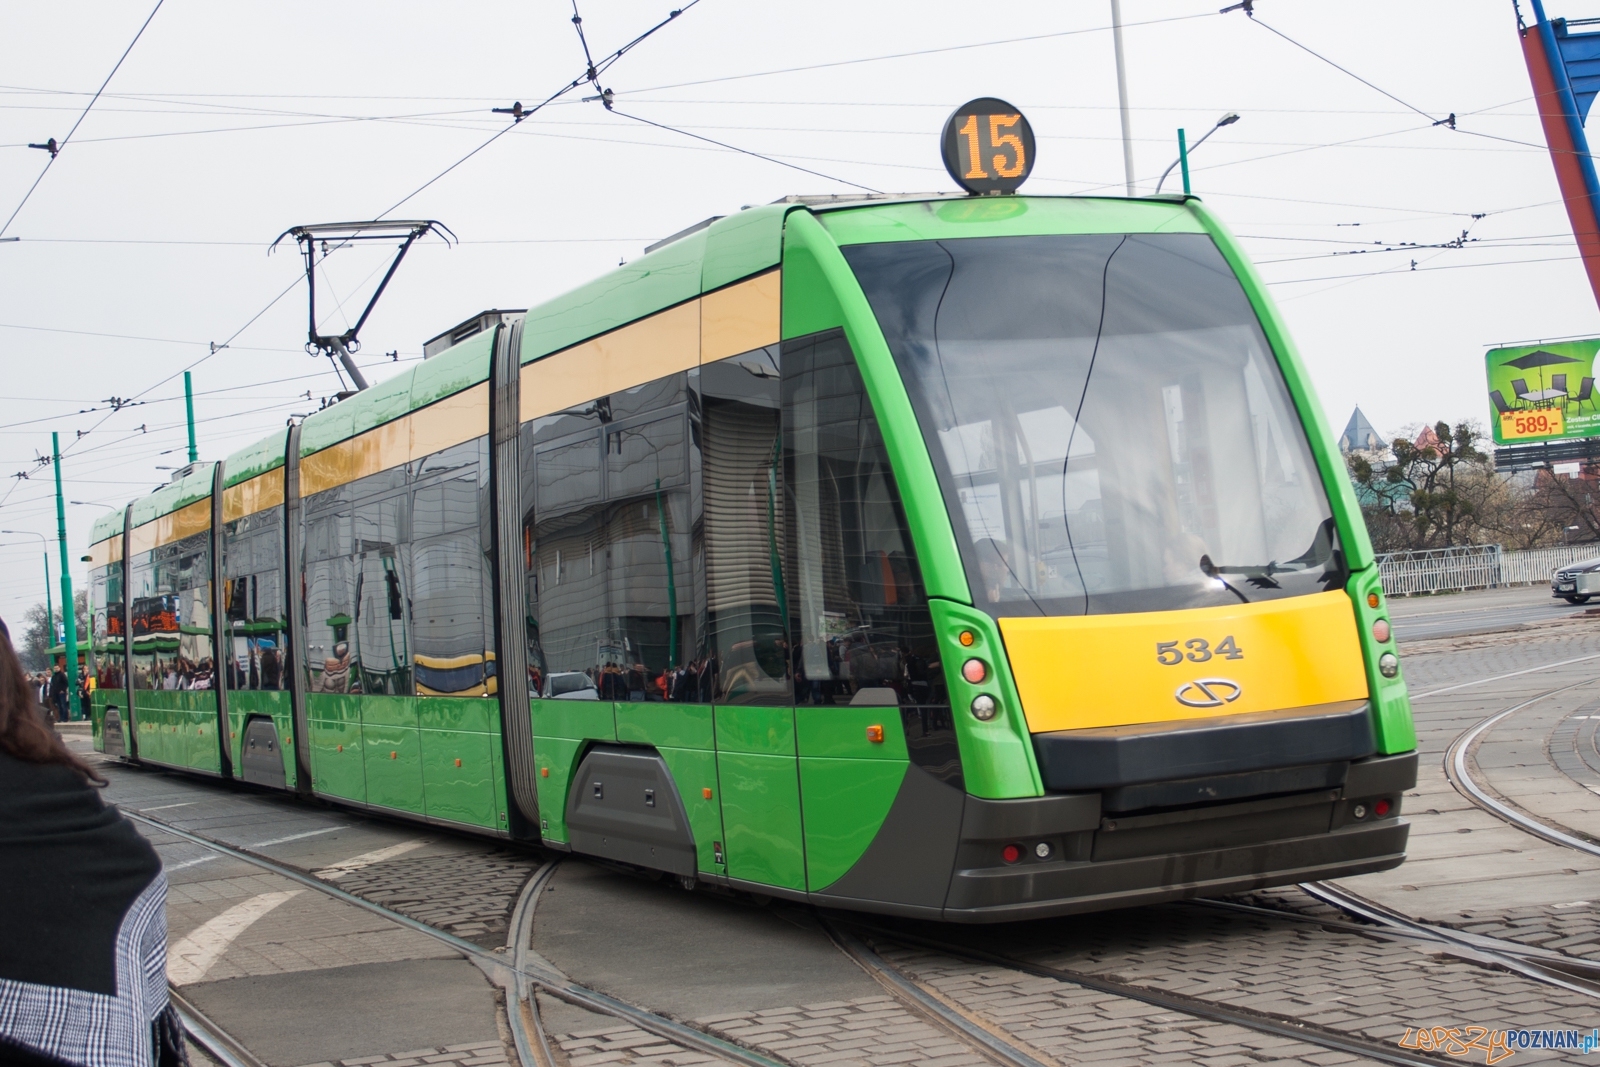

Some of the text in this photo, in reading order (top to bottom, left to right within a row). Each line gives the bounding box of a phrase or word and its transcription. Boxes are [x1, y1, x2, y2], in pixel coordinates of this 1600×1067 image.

[959, 113, 1026, 179] 15
[1515, 415, 1558, 435] 589,-
[1156, 635, 1244, 665] 534
